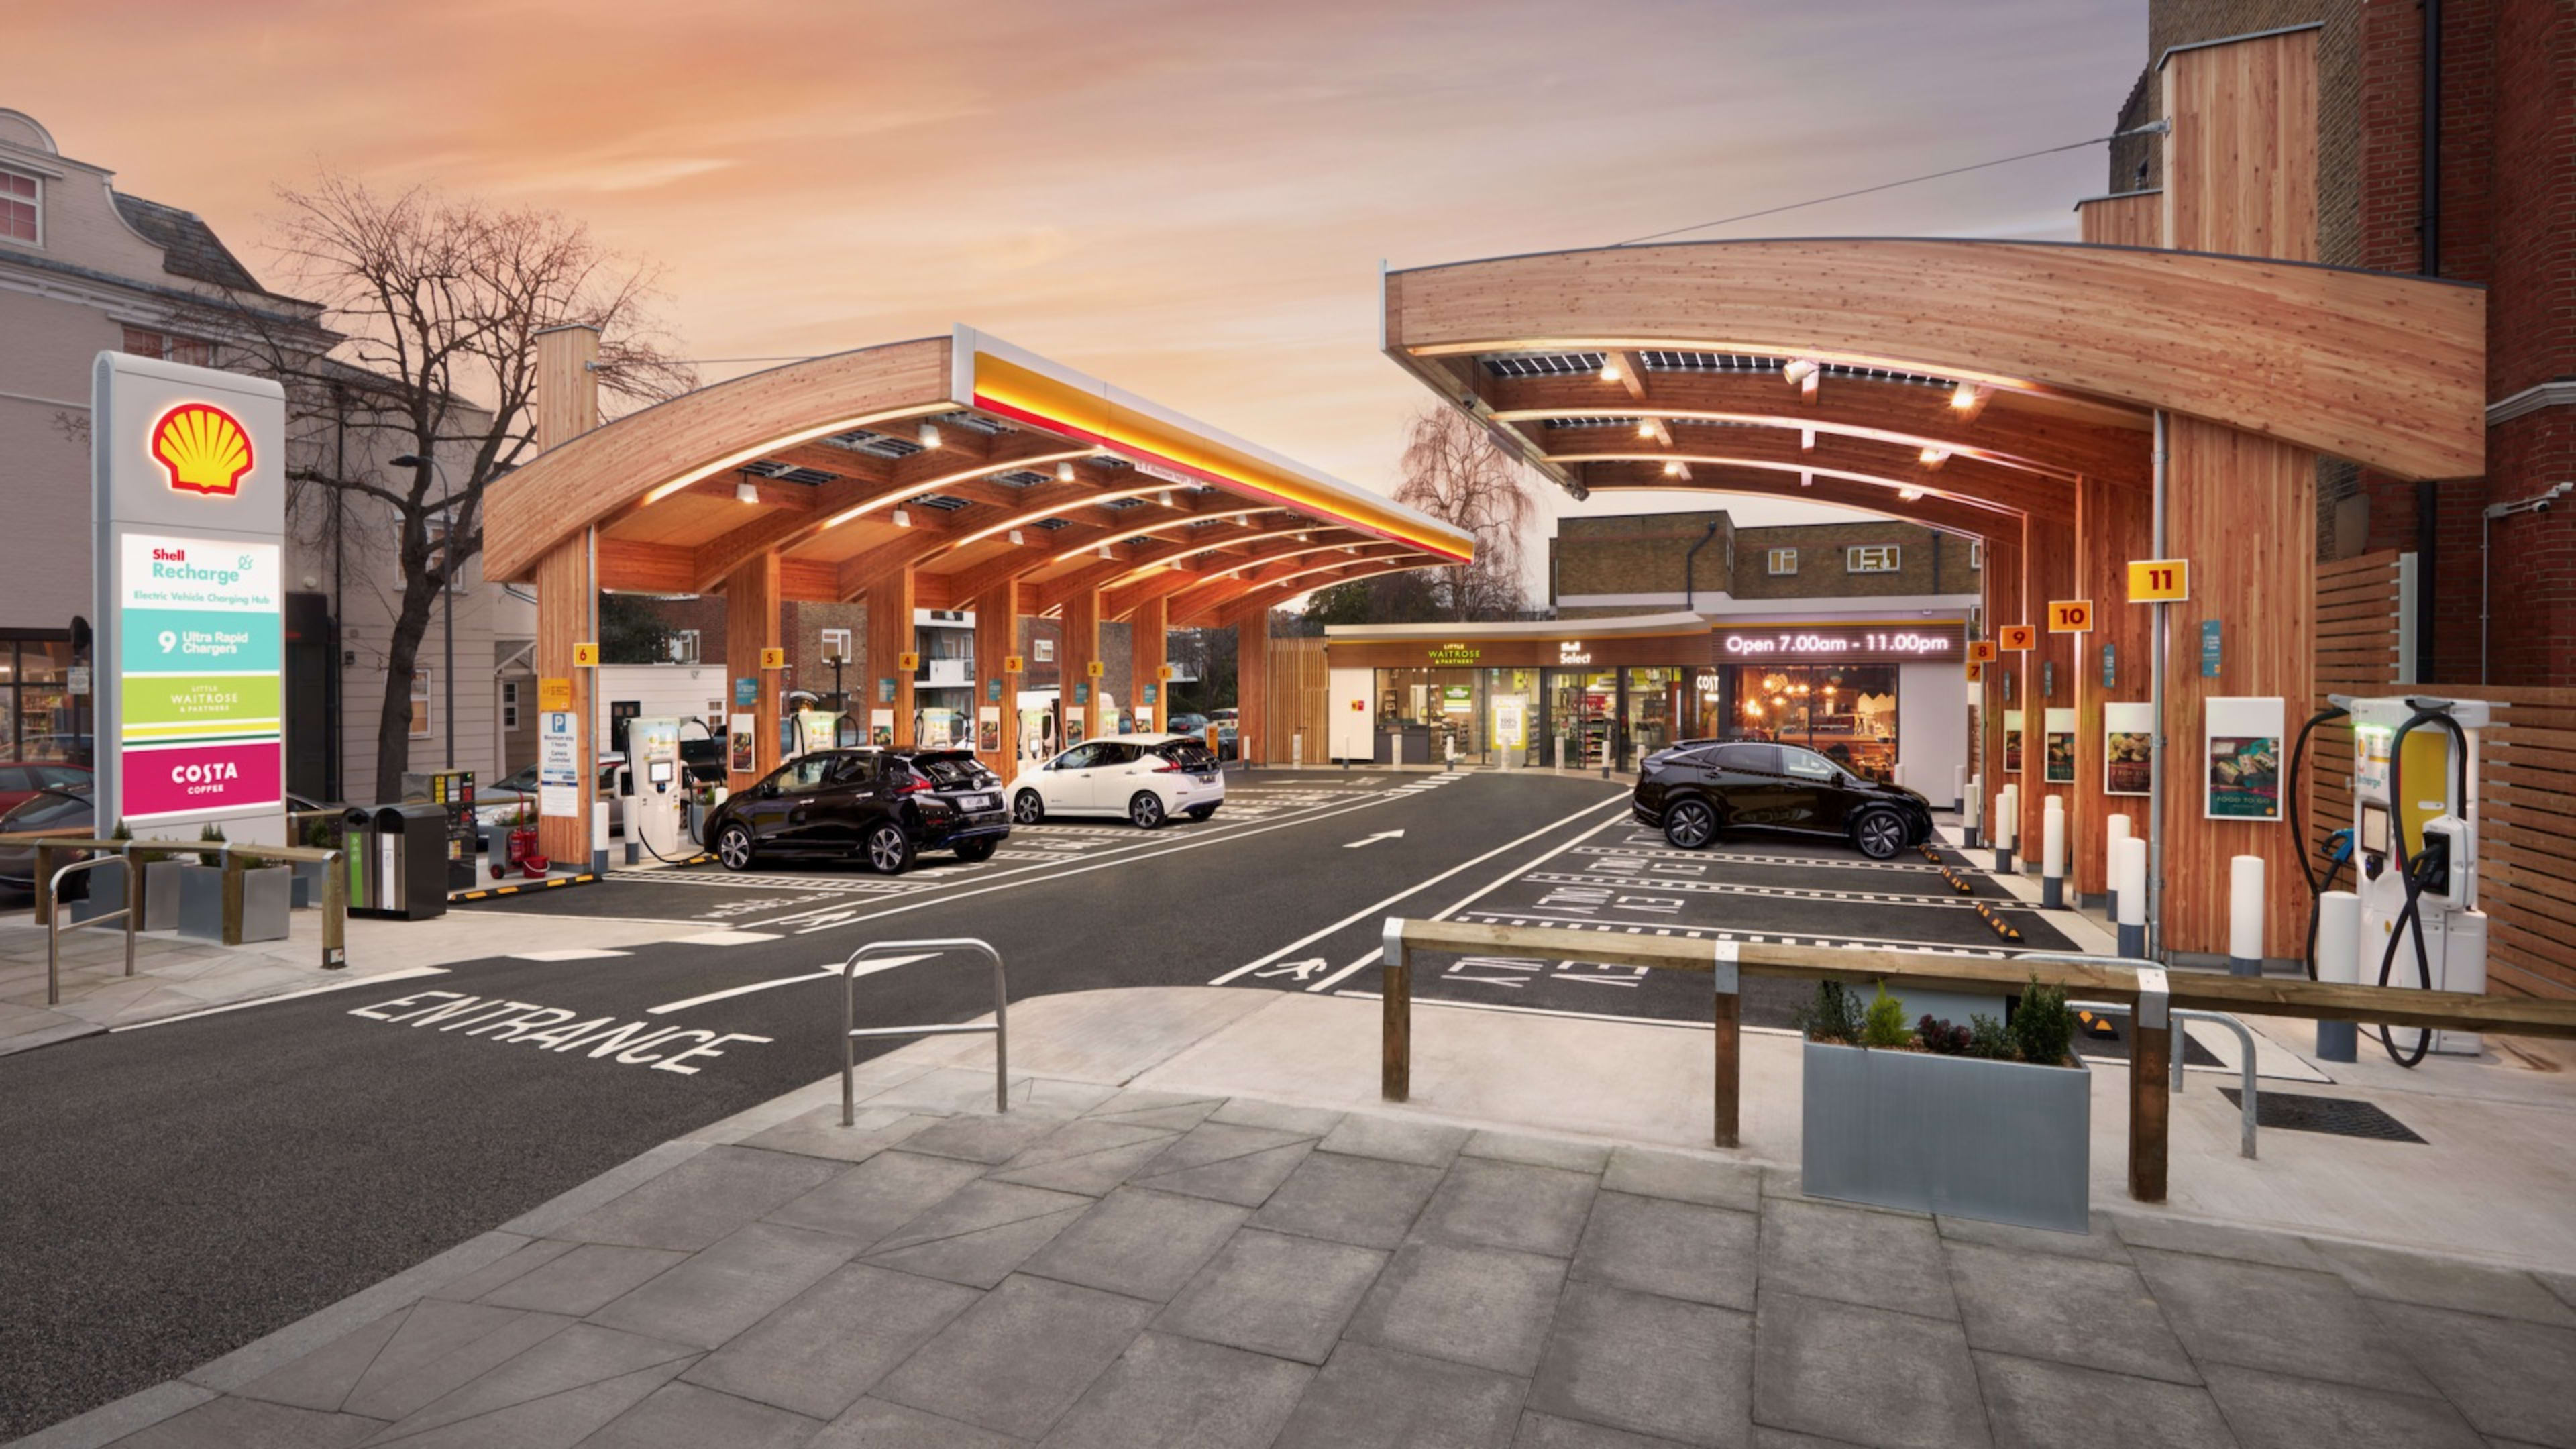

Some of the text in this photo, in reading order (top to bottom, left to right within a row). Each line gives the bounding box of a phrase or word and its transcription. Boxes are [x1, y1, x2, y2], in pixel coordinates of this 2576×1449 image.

[153, 549, 184, 561] Shell
[152, 562, 239, 586] Recharge
[2149, 570, 2172, 590] 11
[133, 590, 270, 605] Electric Vehicle Charging Hub
[2059, 608, 2084, 624] 10
[158, 631, 248, 653] 9 Ultra Rapid
[2013, 631, 2025, 644] 9
[182, 642, 237, 656] Chargers
[1726, 635, 1774, 655] Open
[1779, 635, 1847, 652] 7.00am
[1866, 634, 1949, 654] 11.00pm
[579, 647, 587, 661] 6
[1428, 650, 1481, 658] WAITROSE
[1978, 646, 1987, 657] 8
[767, 653, 773, 664] 5
[904, 656, 911, 666] 4
[1010, 660, 1016, 669] 3
[1560, 652, 1591, 665] Select
[1091, 665, 1097, 674] 2
[1970, 666, 1980, 676] 7
[1696, 674, 1719, 692] COST
[170, 693, 238, 704] WAITROSE
[555, 715, 564, 731] P
[171, 762, 238, 784] COSTA
[187, 784, 224, 794] COFFEE
[347, 990, 775, 1075] ENTRANCE
